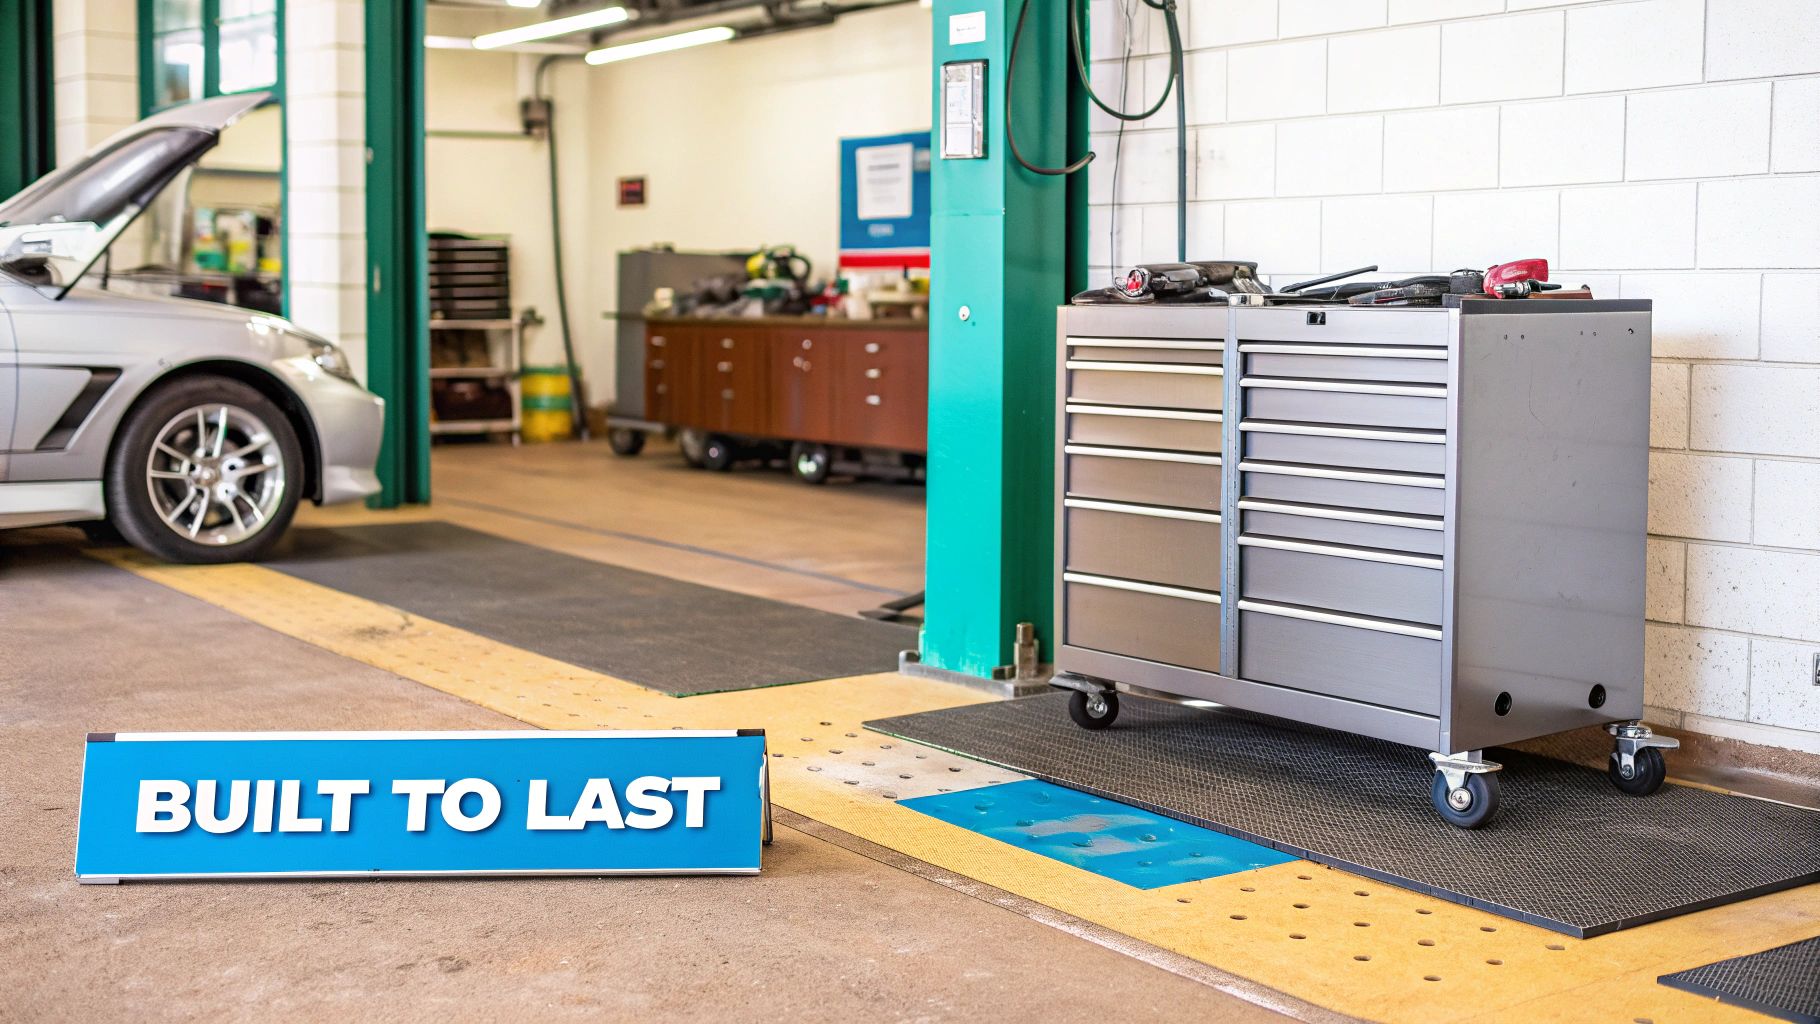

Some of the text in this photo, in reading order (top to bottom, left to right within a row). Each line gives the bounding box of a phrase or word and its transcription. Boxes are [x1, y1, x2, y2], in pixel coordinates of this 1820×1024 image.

[136, 776, 721, 833] BUILT TO LAST
